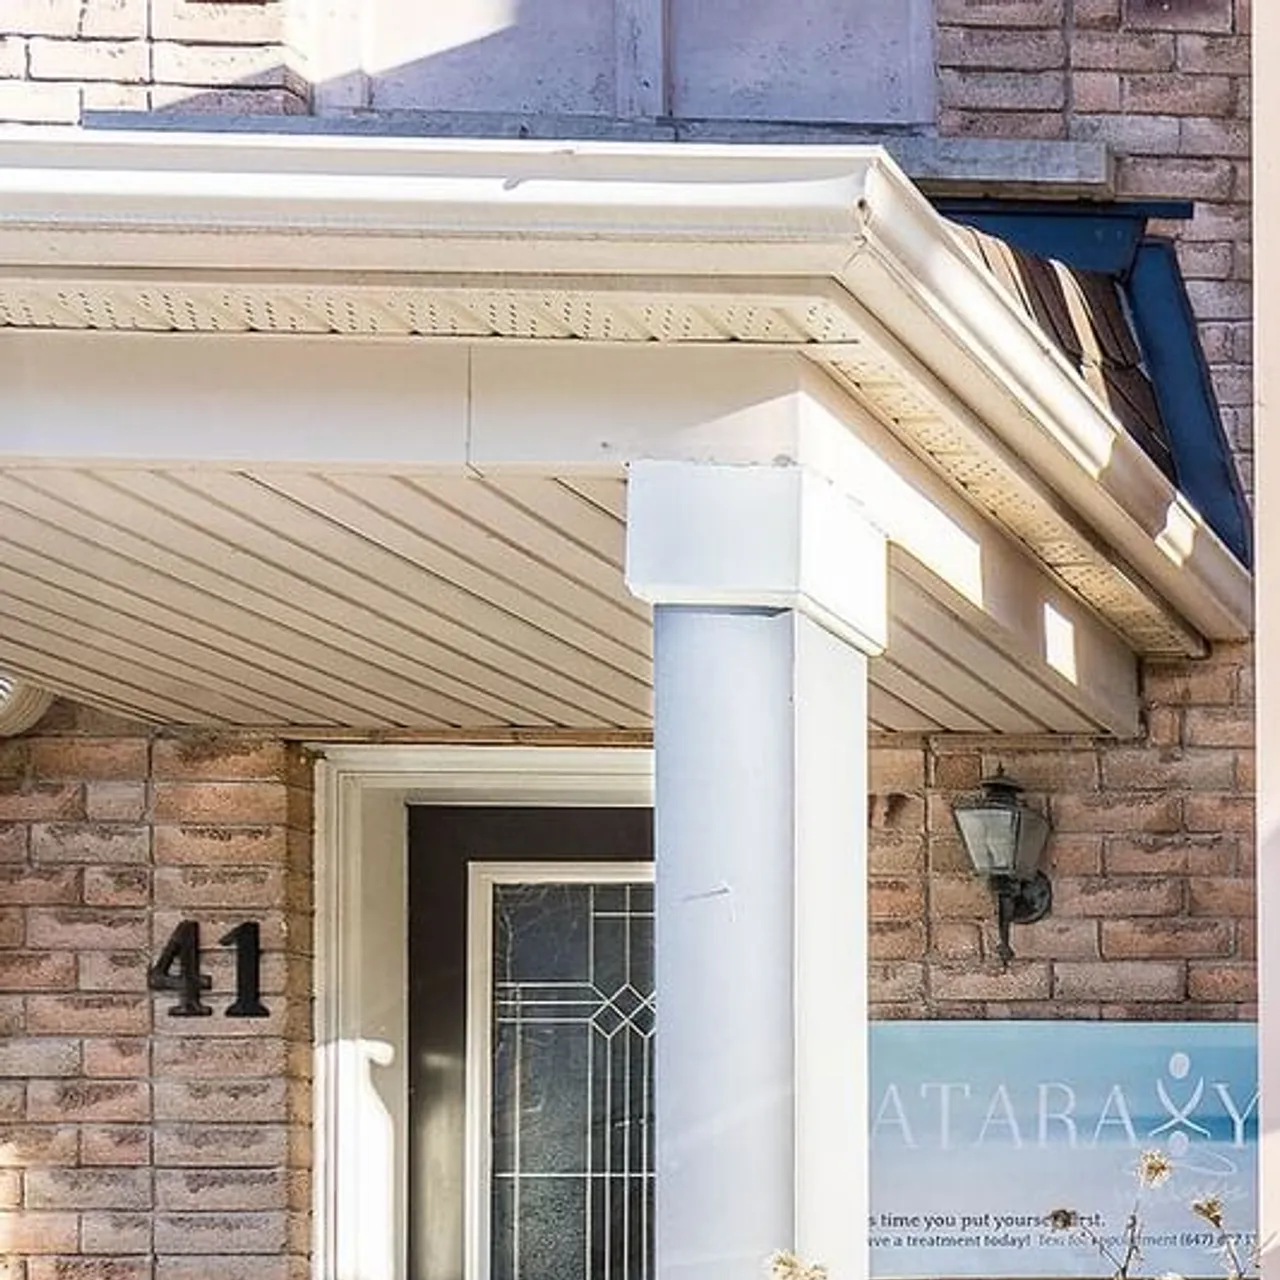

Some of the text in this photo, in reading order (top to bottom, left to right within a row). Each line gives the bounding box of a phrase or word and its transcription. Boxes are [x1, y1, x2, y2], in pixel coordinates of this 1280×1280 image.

[147, 919, 271, 1018] 41
[872, 1064, 1259, 1150] ATARAXY
[880, 1212, 920, 1227] time
[923, 1215, 957, 1231] you
[961, 1214, 990, 1231] put
[893, 1237, 903, 1247] a
[906, 1235, 981, 1247] treatment
[984, 1234, 1031, 1249] today!
